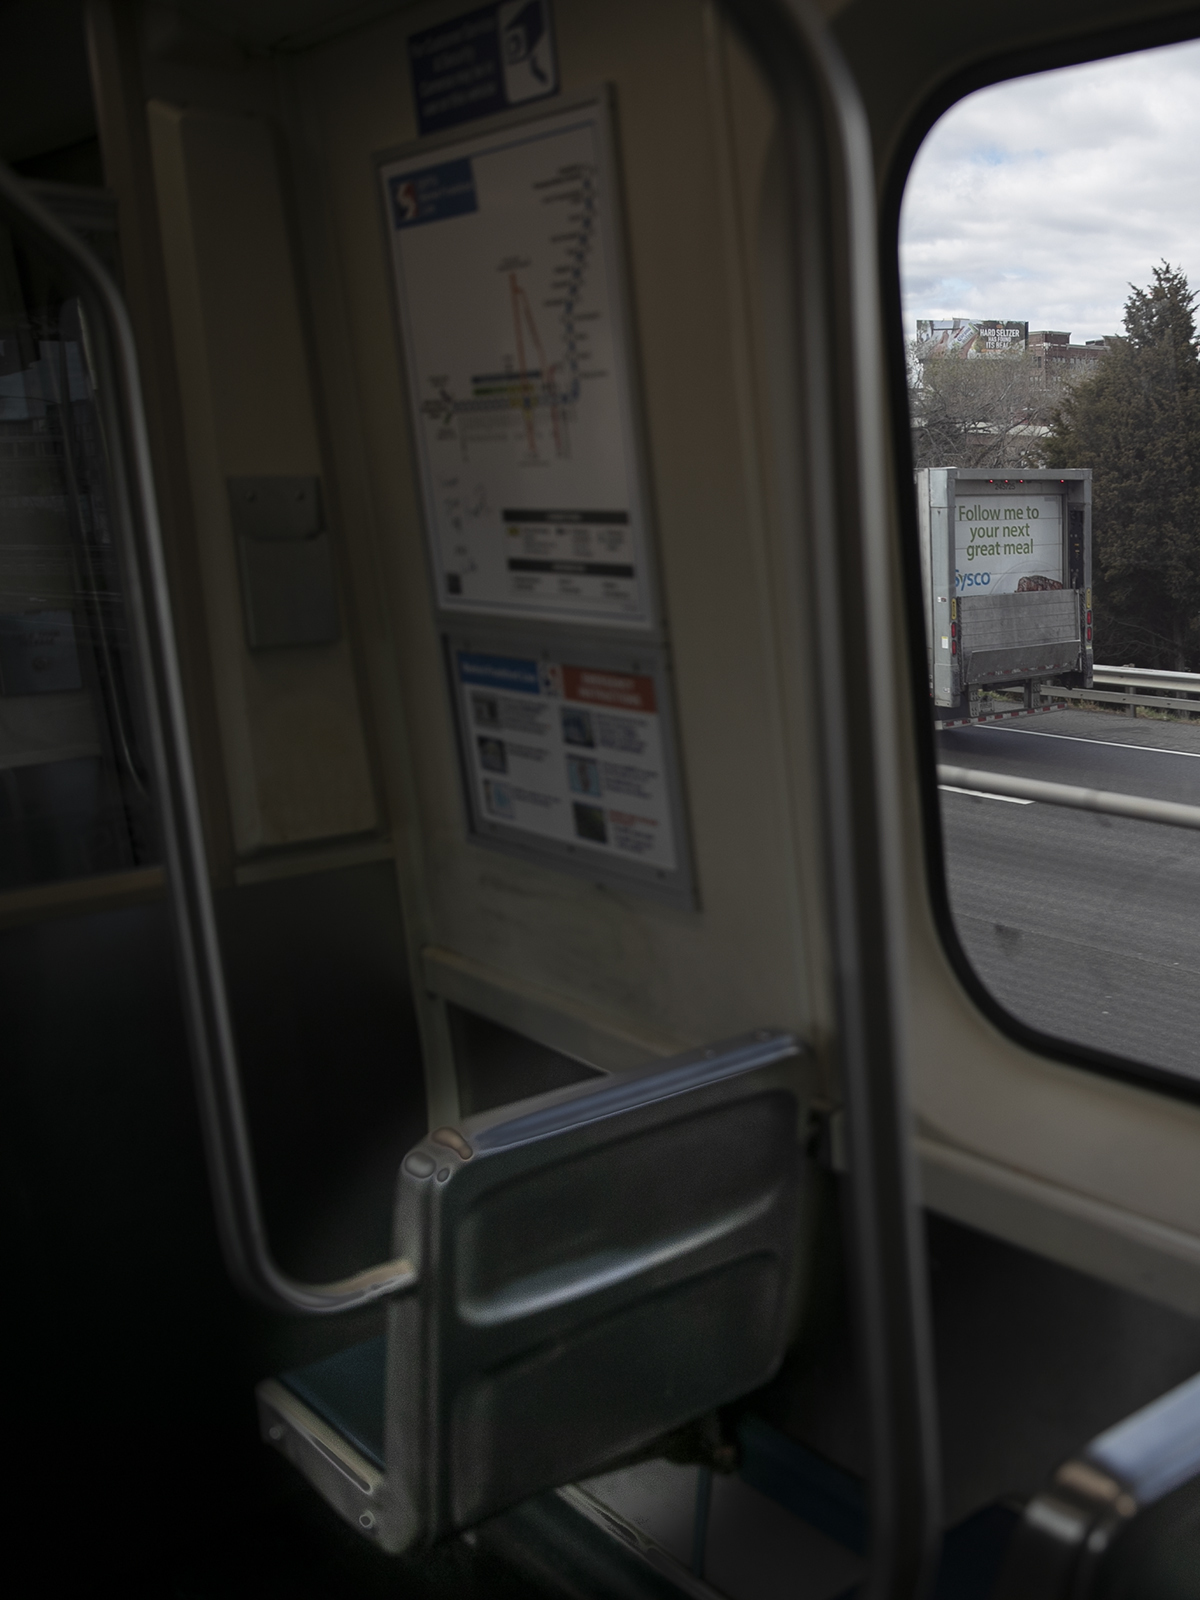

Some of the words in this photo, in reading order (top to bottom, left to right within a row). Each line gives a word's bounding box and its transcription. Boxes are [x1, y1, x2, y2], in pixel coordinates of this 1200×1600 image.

[980, 328, 996, 337] HARD
[996, 328, 1020, 337] SELTZER
[958, 504, 1001, 521] Follow
[1004, 507, 1024, 520] me
[1026, 505, 1040, 520] to
[969, 526, 999, 543] your
[1002, 523, 1030, 538] next
[966, 541, 1001, 561] great
[1003, 538, 1034, 555] meal
